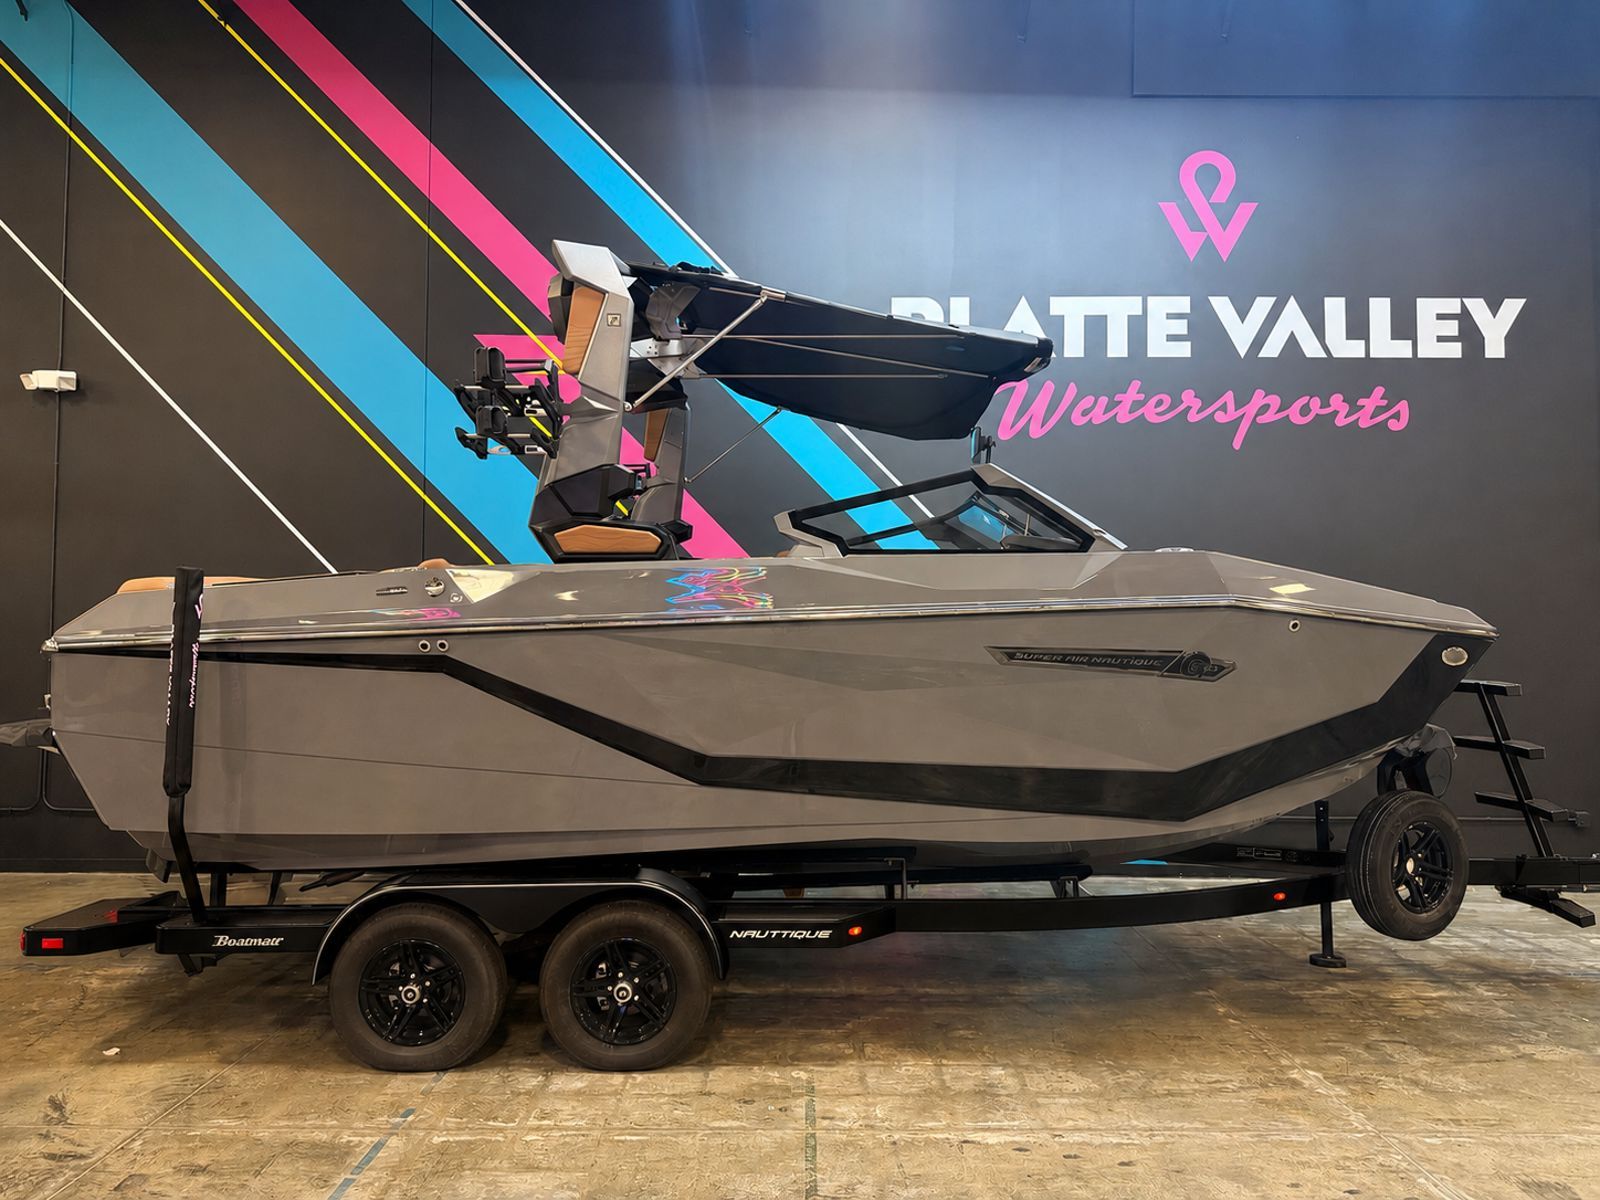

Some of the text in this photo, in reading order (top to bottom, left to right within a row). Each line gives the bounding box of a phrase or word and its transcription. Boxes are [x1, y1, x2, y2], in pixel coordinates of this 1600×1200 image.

[1208, 296, 1527, 358] VALLEY
[994, 379, 1410, 450] Watersports
[1014, 652, 1163, 666] SUPER AIR NAUTIQUE
